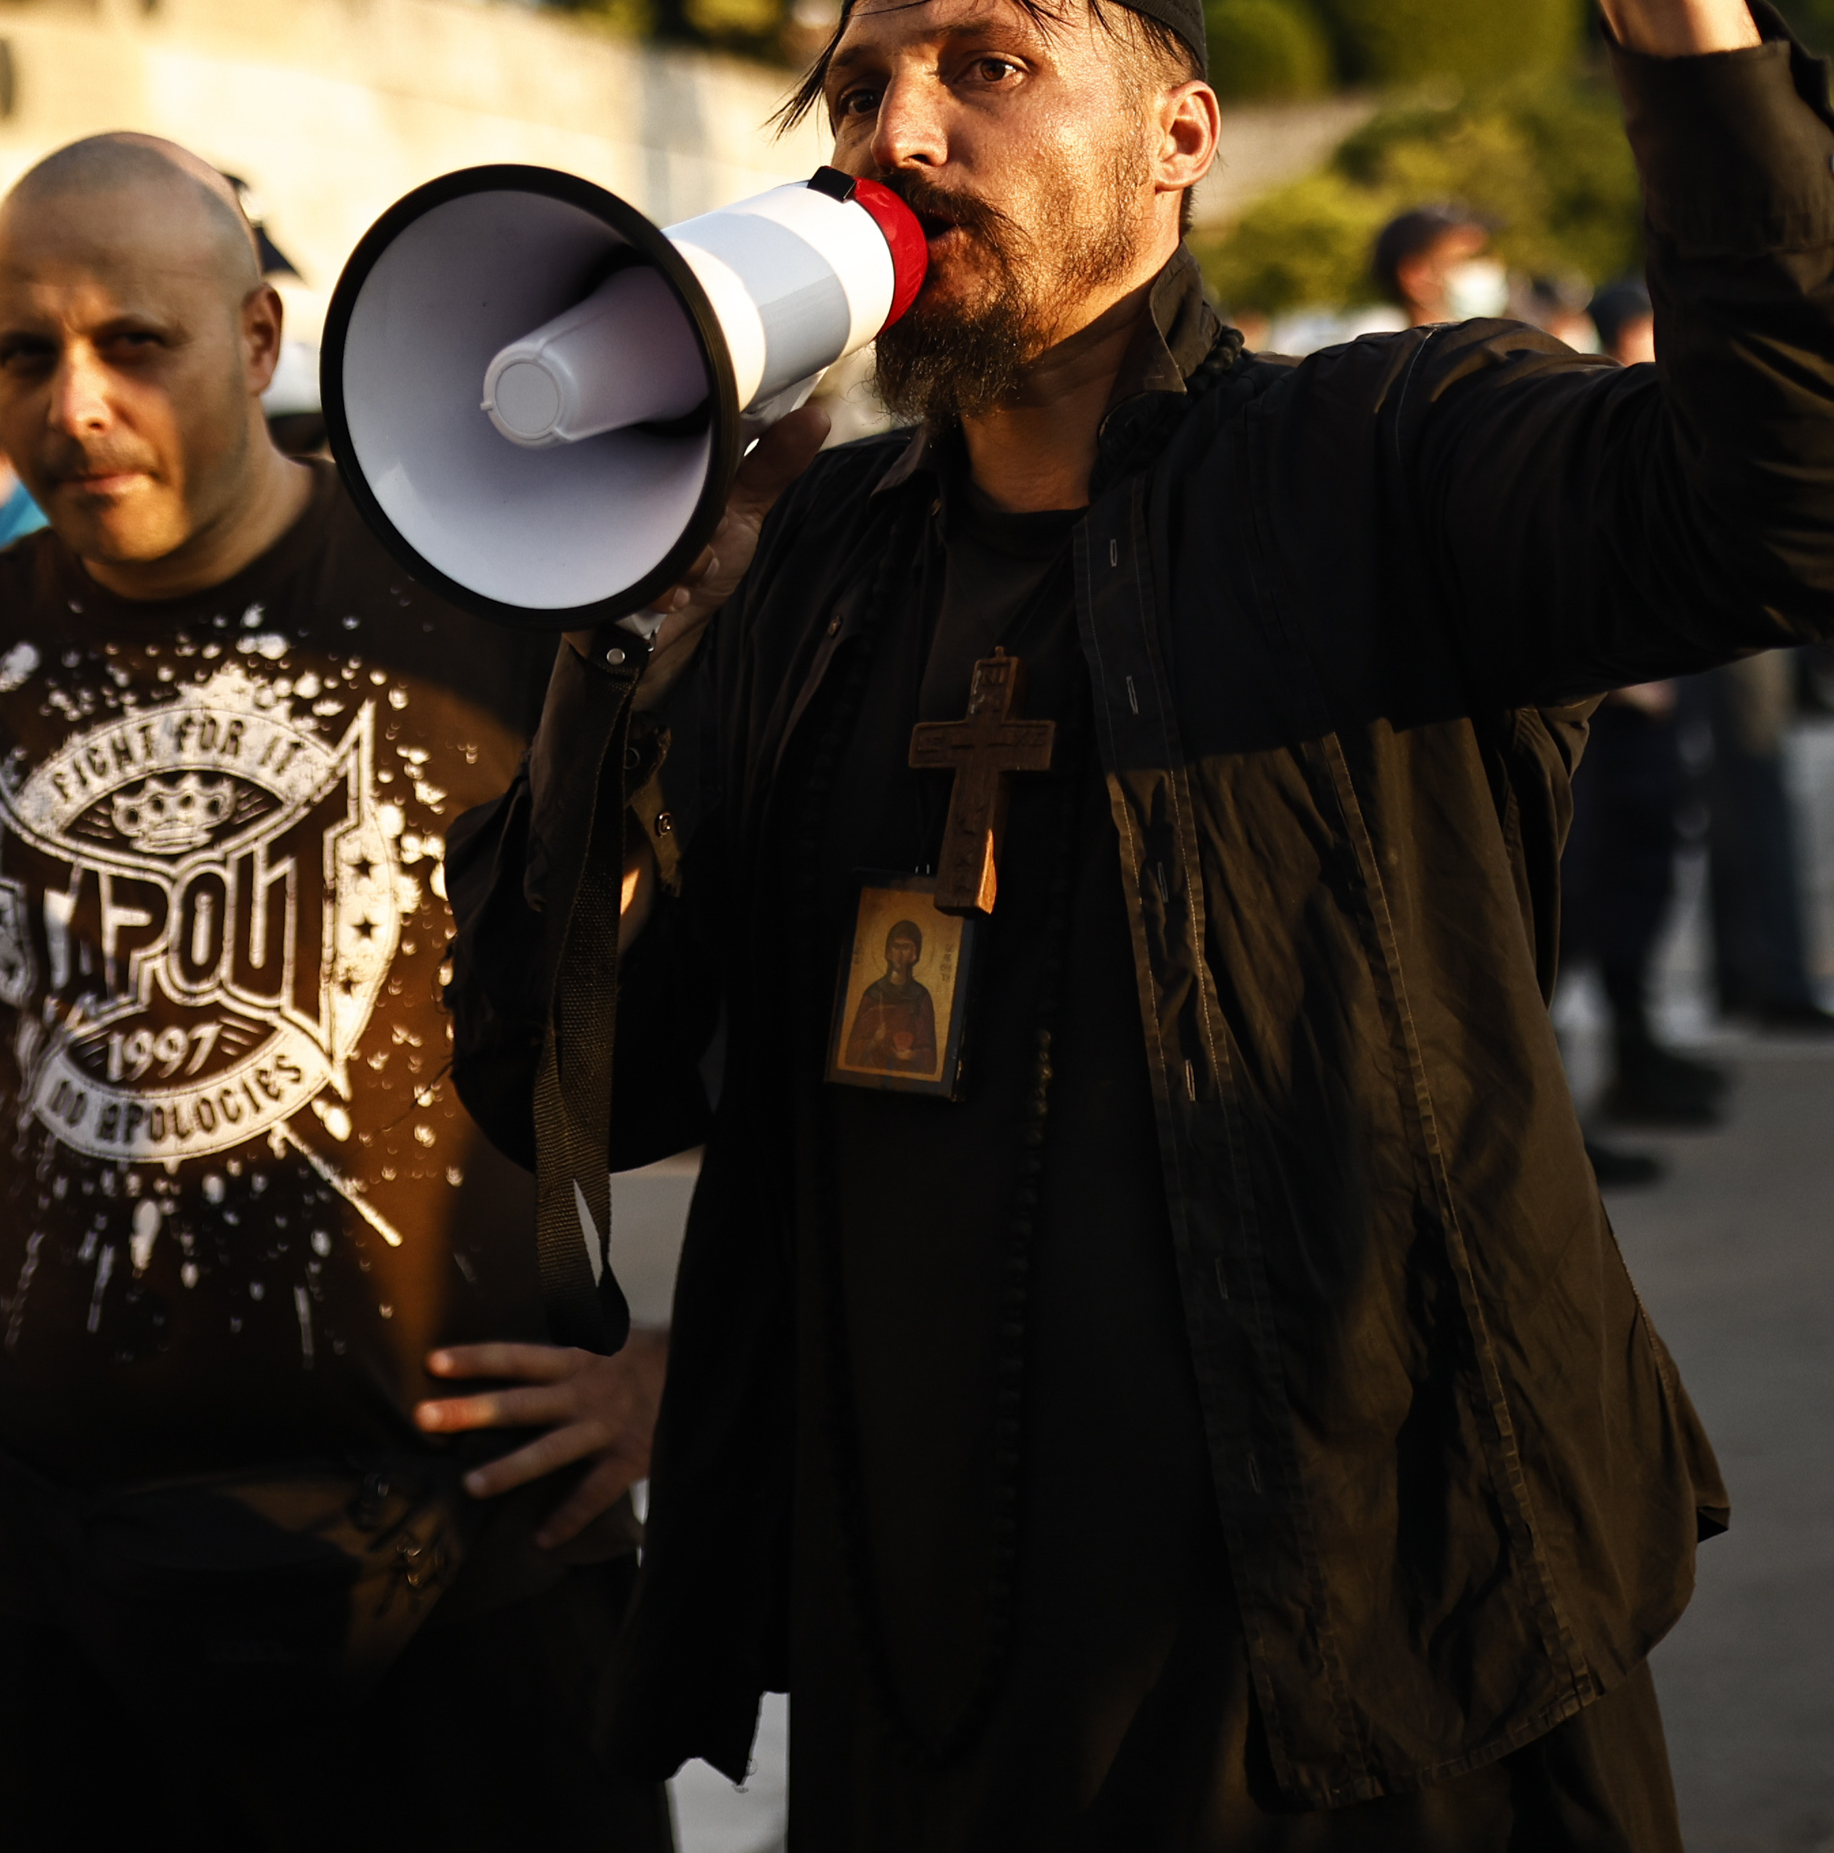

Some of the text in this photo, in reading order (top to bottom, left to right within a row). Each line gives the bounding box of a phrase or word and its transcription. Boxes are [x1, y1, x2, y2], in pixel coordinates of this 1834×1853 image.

[52, 715, 305, 803] FIGHT FOR IT
[105, 1022, 224, 1084] 1997
[47, 1054, 303, 1144] NO APOLOGIES
